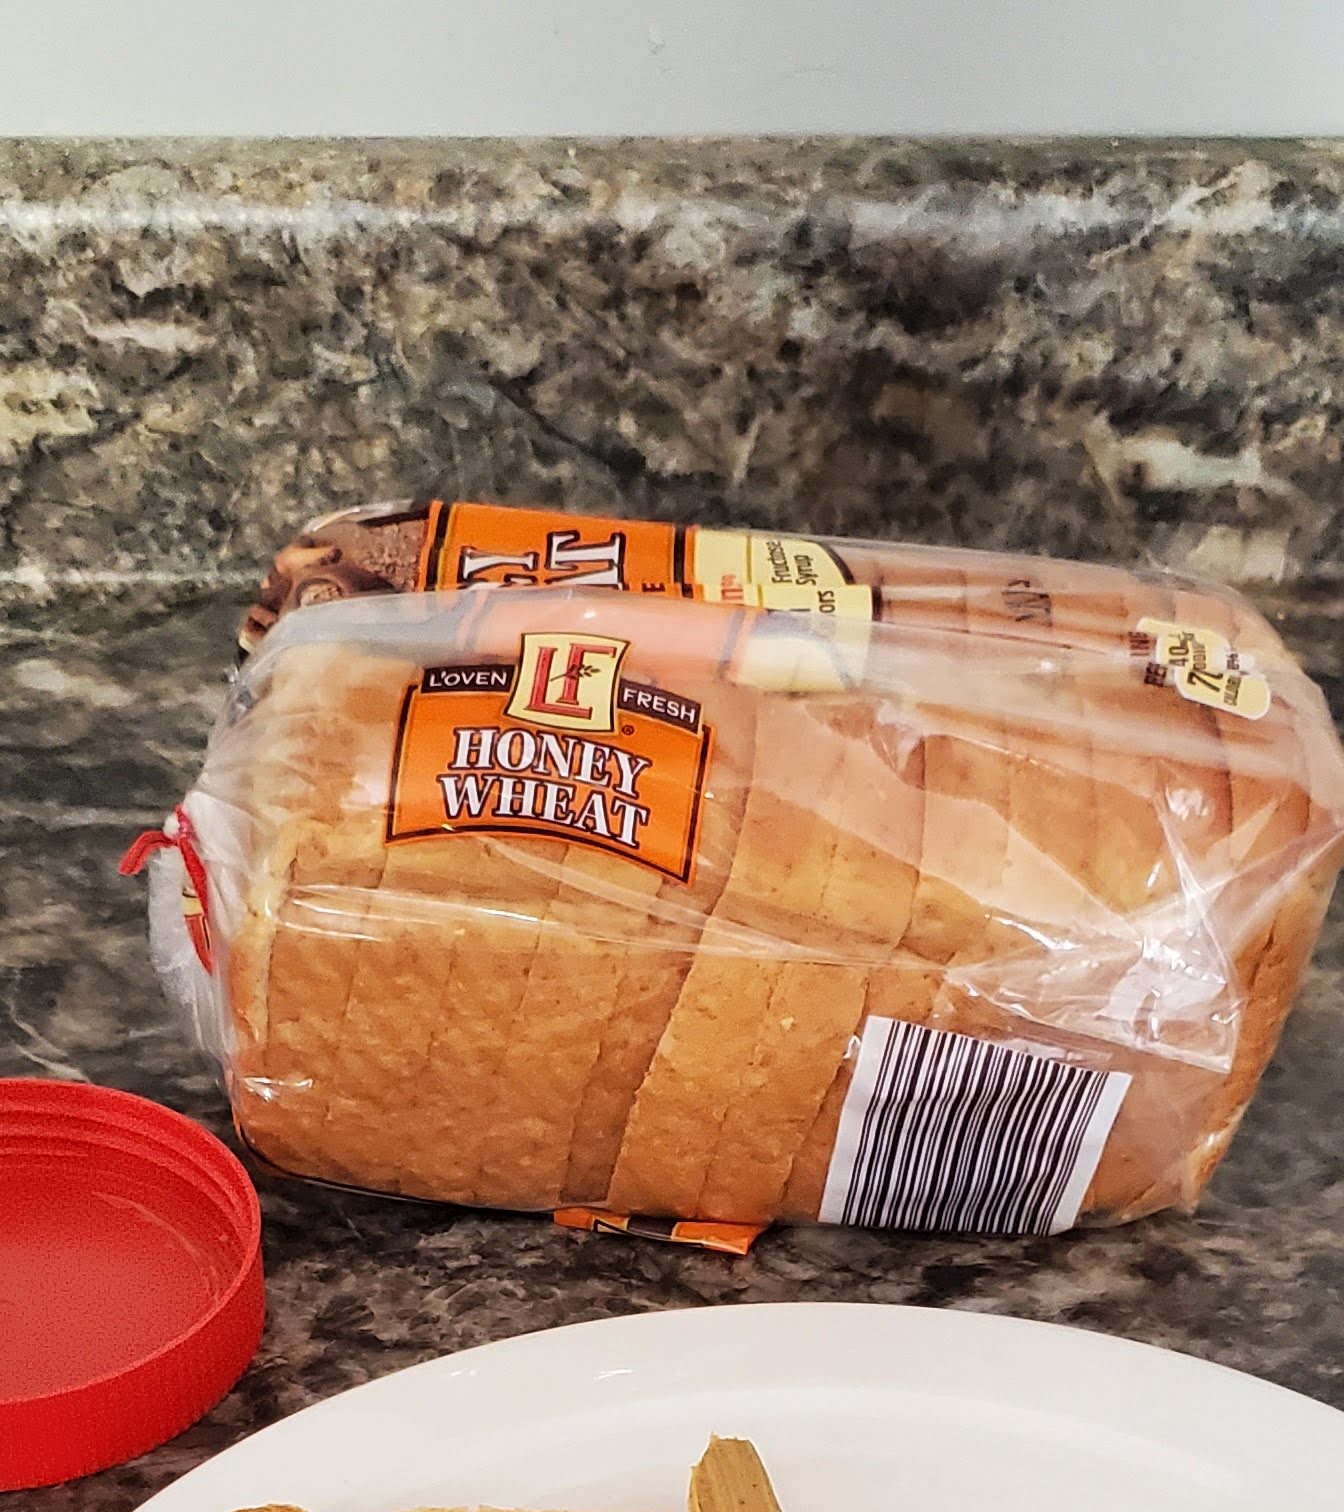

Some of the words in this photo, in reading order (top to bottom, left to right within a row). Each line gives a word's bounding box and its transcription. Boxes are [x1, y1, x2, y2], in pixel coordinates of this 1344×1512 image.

[793, 554, 819, 586] Syrup
[429, 669, 507, 689] L'OVEN
[622, 687, 696, 725] FRESH
[450, 726, 652, 800] HONEY
[438, 773, 649, 847] WHEAT
